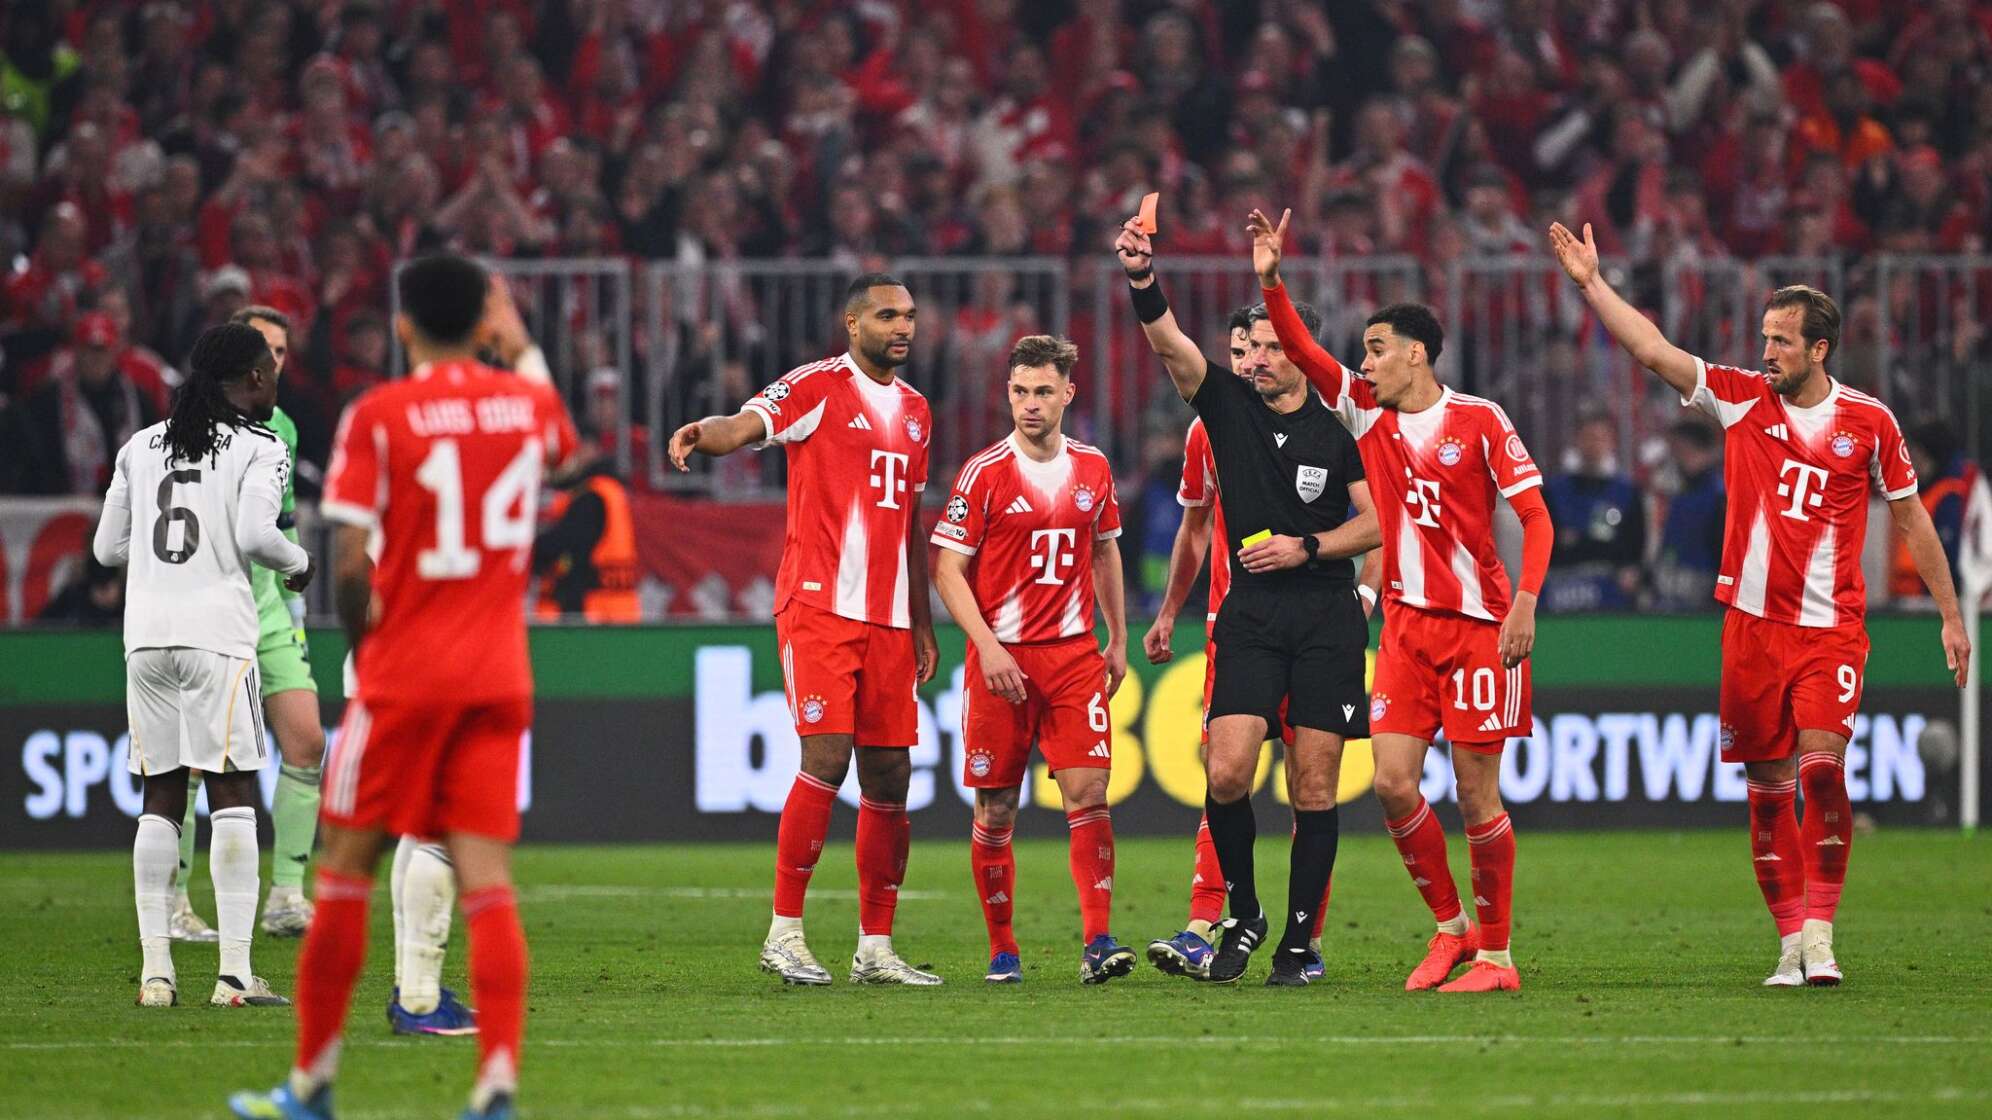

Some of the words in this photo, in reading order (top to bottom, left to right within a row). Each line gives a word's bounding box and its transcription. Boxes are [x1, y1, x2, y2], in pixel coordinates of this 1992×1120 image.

[415, 433, 544, 580] 14
[869, 448, 909, 510] T
[1777, 458, 1830, 522] T
[152, 468, 202, 565] 6
[1031, 528, 1076, 586] T
[1087, 691, 1108, 733] 6
[1452, 667, 1496, 711] 10
[1837, 664, 1857, 704] 9
[1418, 711, 1926, 804] SORTWEEN
